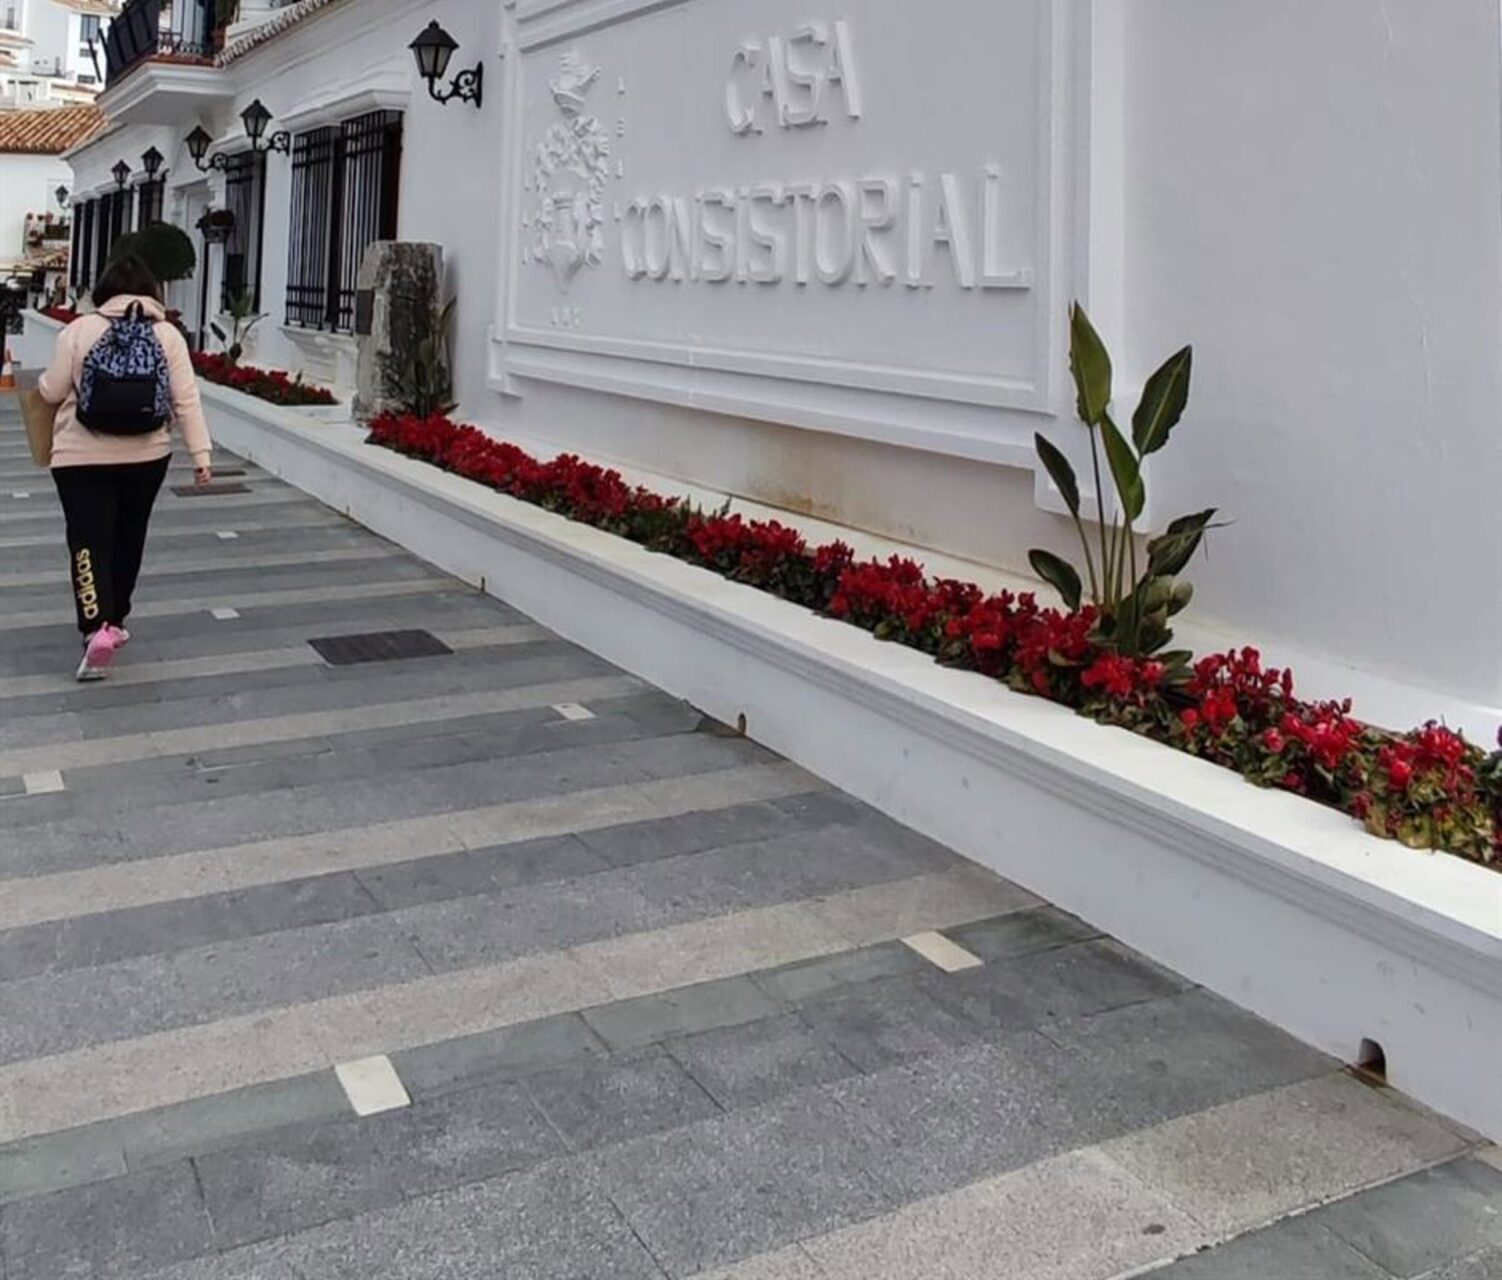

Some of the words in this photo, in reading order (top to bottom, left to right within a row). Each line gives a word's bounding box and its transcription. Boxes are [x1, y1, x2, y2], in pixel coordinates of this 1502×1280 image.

[724, 19, 862, 135] CASA
[620, 163, 1031, 288] CONSISTORIAL
[76, 548, 99, 619] adidas
